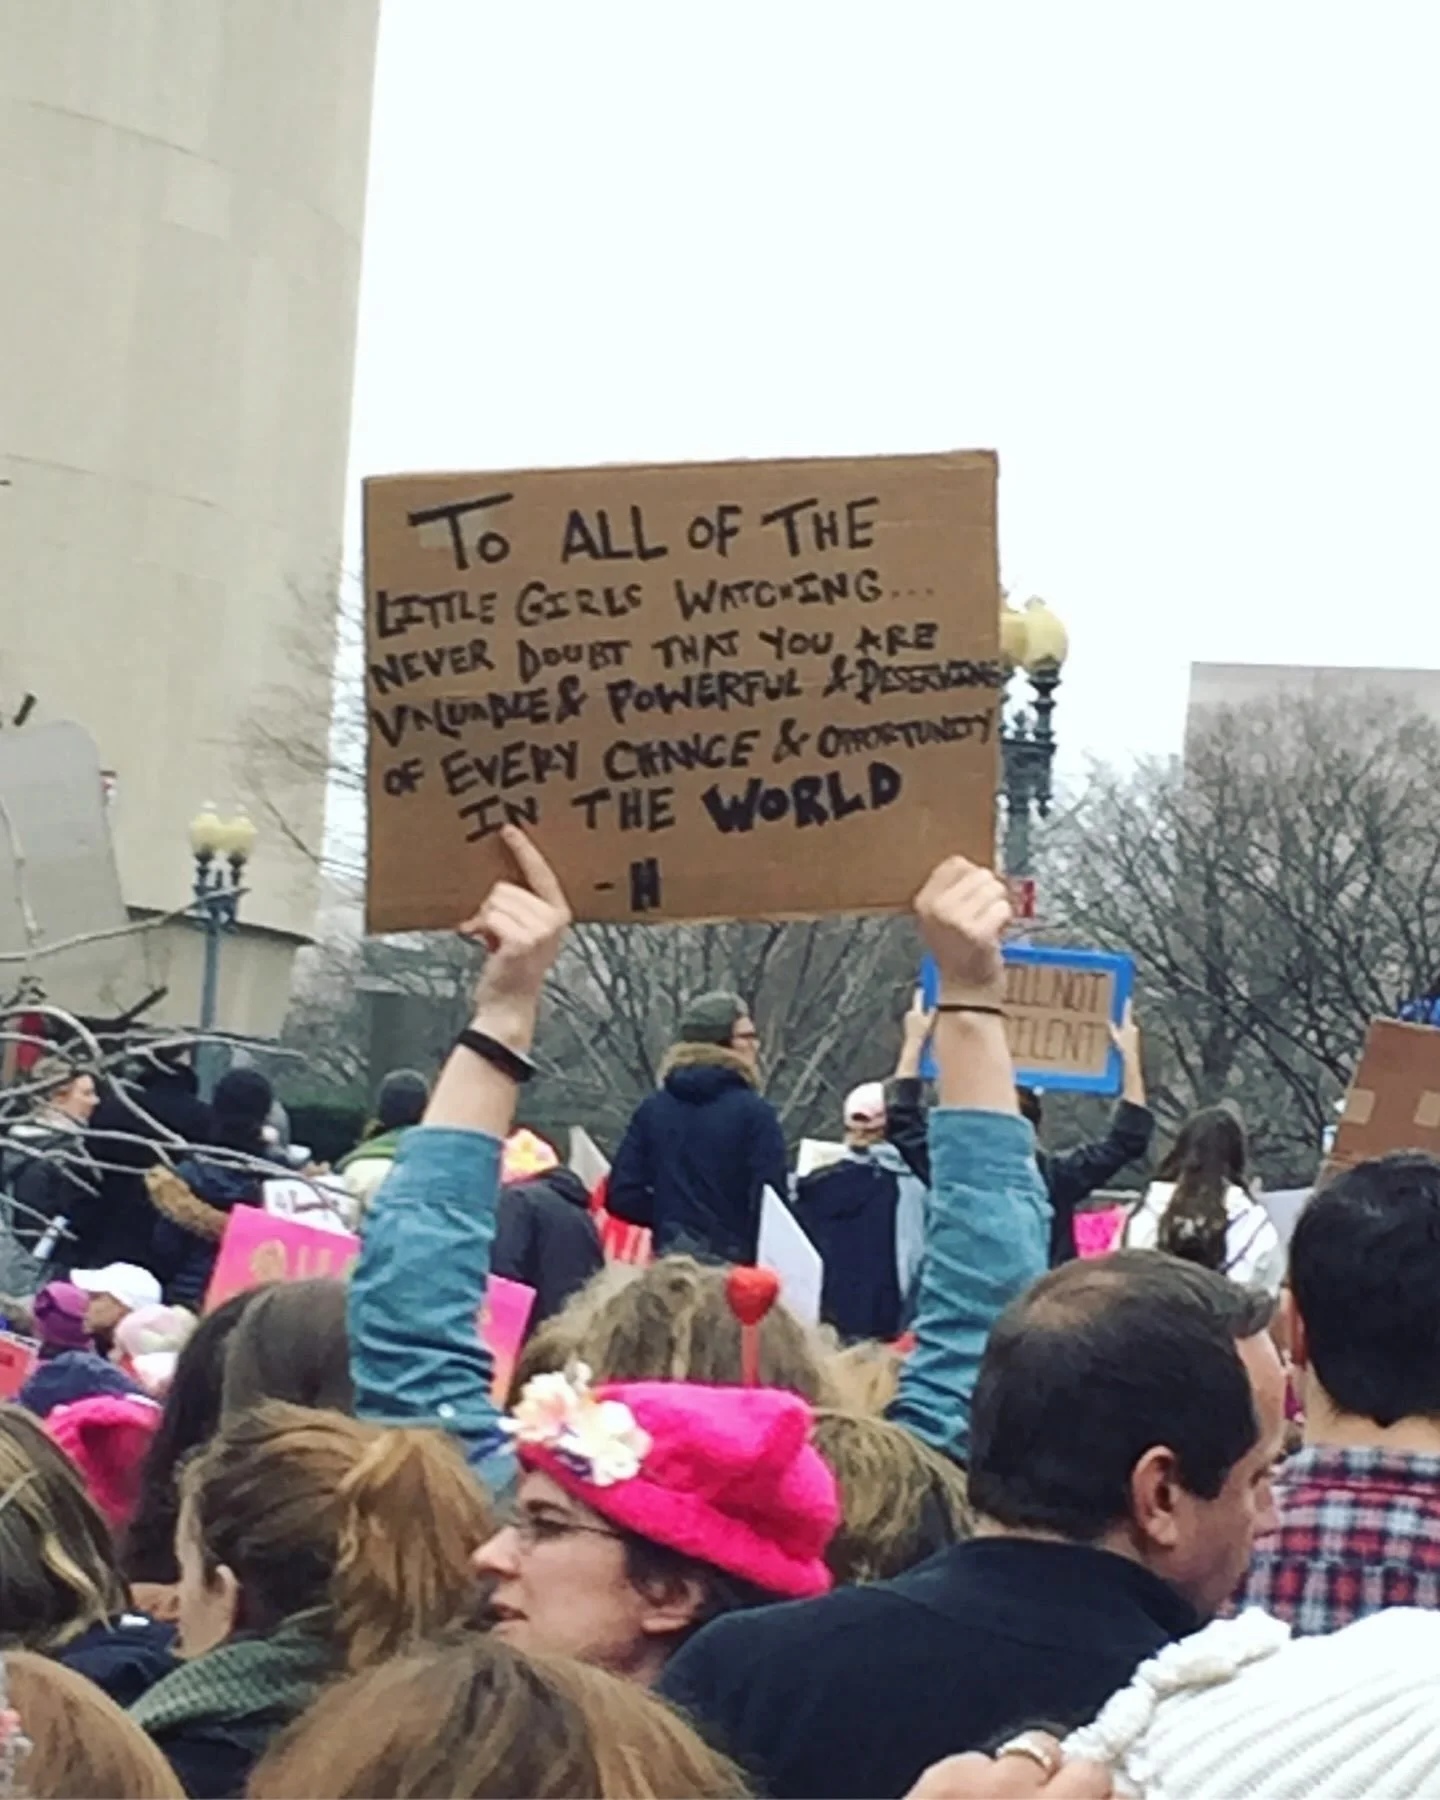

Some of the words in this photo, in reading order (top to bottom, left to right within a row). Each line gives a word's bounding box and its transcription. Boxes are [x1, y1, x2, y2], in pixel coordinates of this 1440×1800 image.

[561, 504, 668, 564] ALL
[687, 504, 742, 557] OF
[760, 496, 880, 557] THE
[376, 589, 497, 639] LITTLE
[515, 580, 642, 627] GIRLS
[367, 638, 496, 695] NEVER
[516, 638, 632, 684] DOUBT
[651, 629, 739, 668] THAT
[758, 625, 834, 660] YOU
[856, 622, 939, 656] ARE
[556, 674, 589, 725] &
[606, 667, 803, 724] POWERFUL
[383, 757, 425, 796] OF
[440, 740, 579, 797] EVERY
[603, 729, 761, 783] CHANCE
[771, 717, 811, 765] &
[458, 794, 540, 844] IN
[571, 786, 677, 833] THE
[701, 761, 902, 834] WORLD
[1002, 963, 1047, 1006] ILL
[1051, 968, 1108, 1013] NOT
[1007, 1014, 1109, 1064] ILENT
